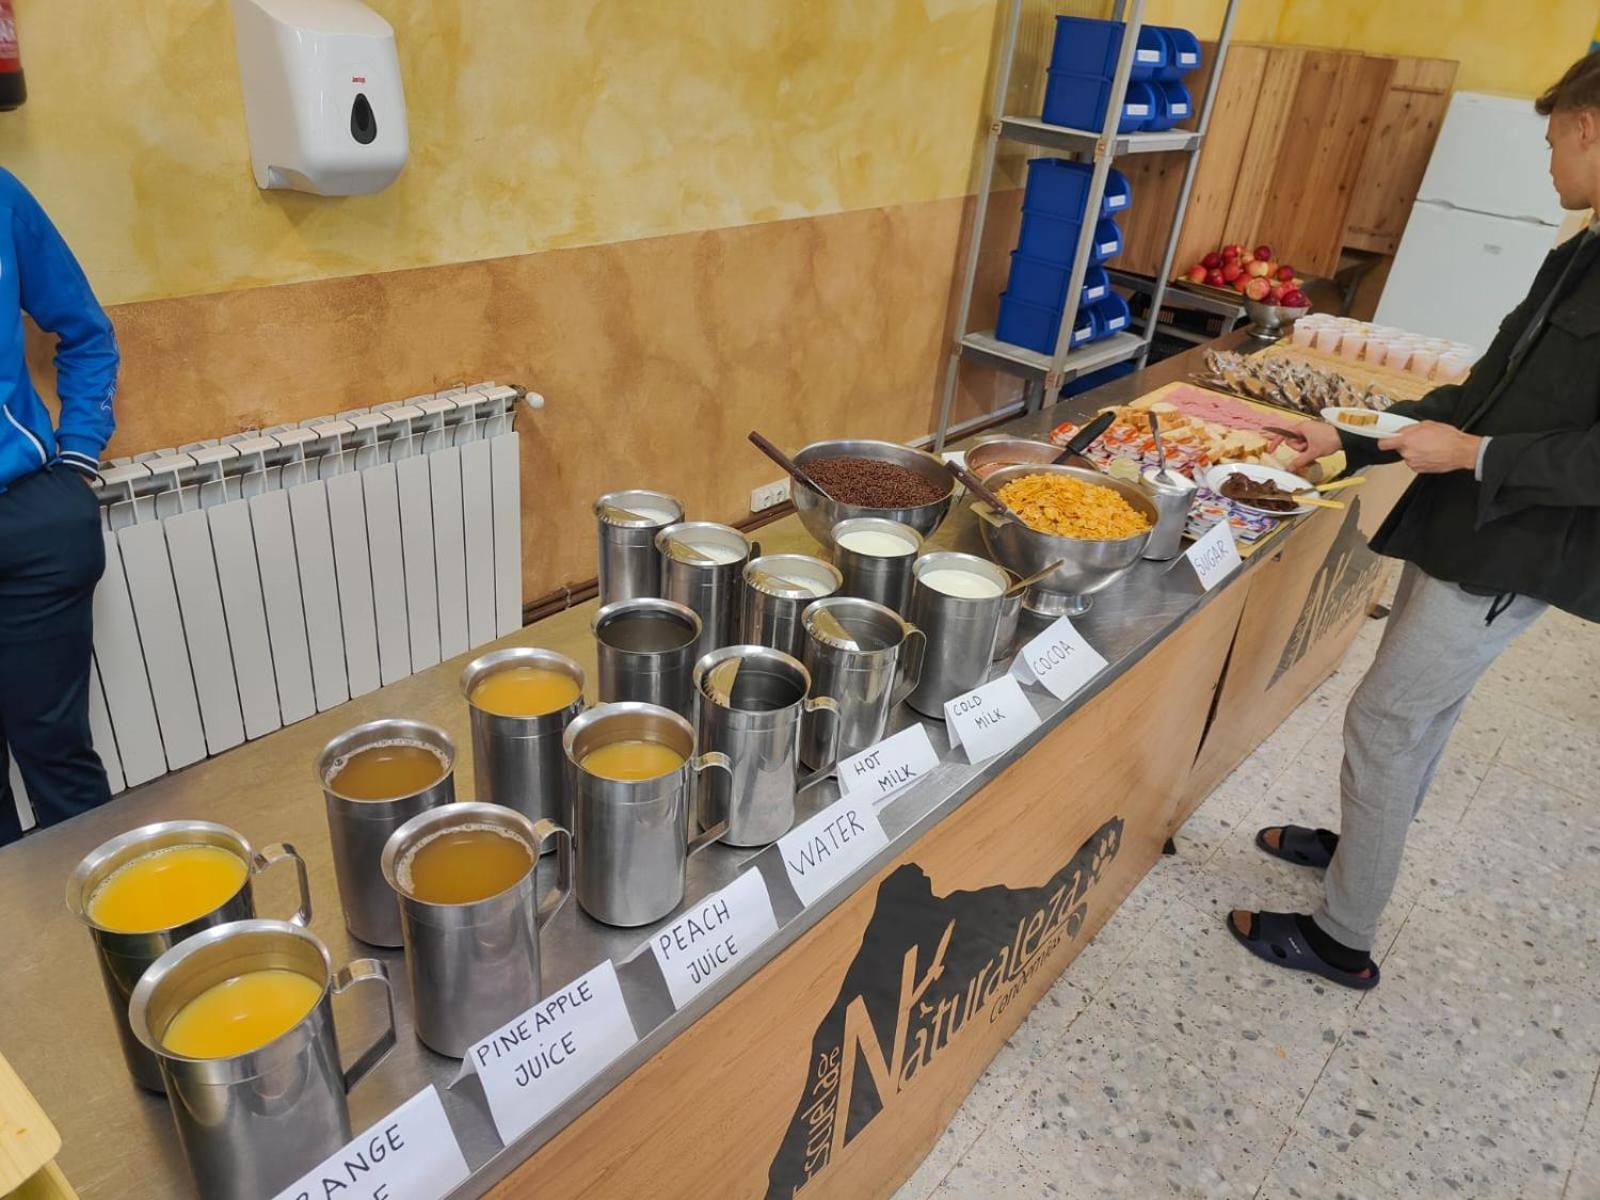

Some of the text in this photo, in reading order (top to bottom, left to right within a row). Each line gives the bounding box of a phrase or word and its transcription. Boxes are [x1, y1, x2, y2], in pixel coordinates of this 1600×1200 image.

[1194, 540, 1229, 576] SUGAR
[1033, 640, 1074, 676] COCOA
[953, 695, 983, 716] COLD
[854, 750, 880, 775] HOT
[788, 810, 865, 876] WATER
[659, 899, 730, 960] PEACH
[842, 869, 1081, 1149] Naturaleza
[296, 1123, 405, 1200] ANGE
